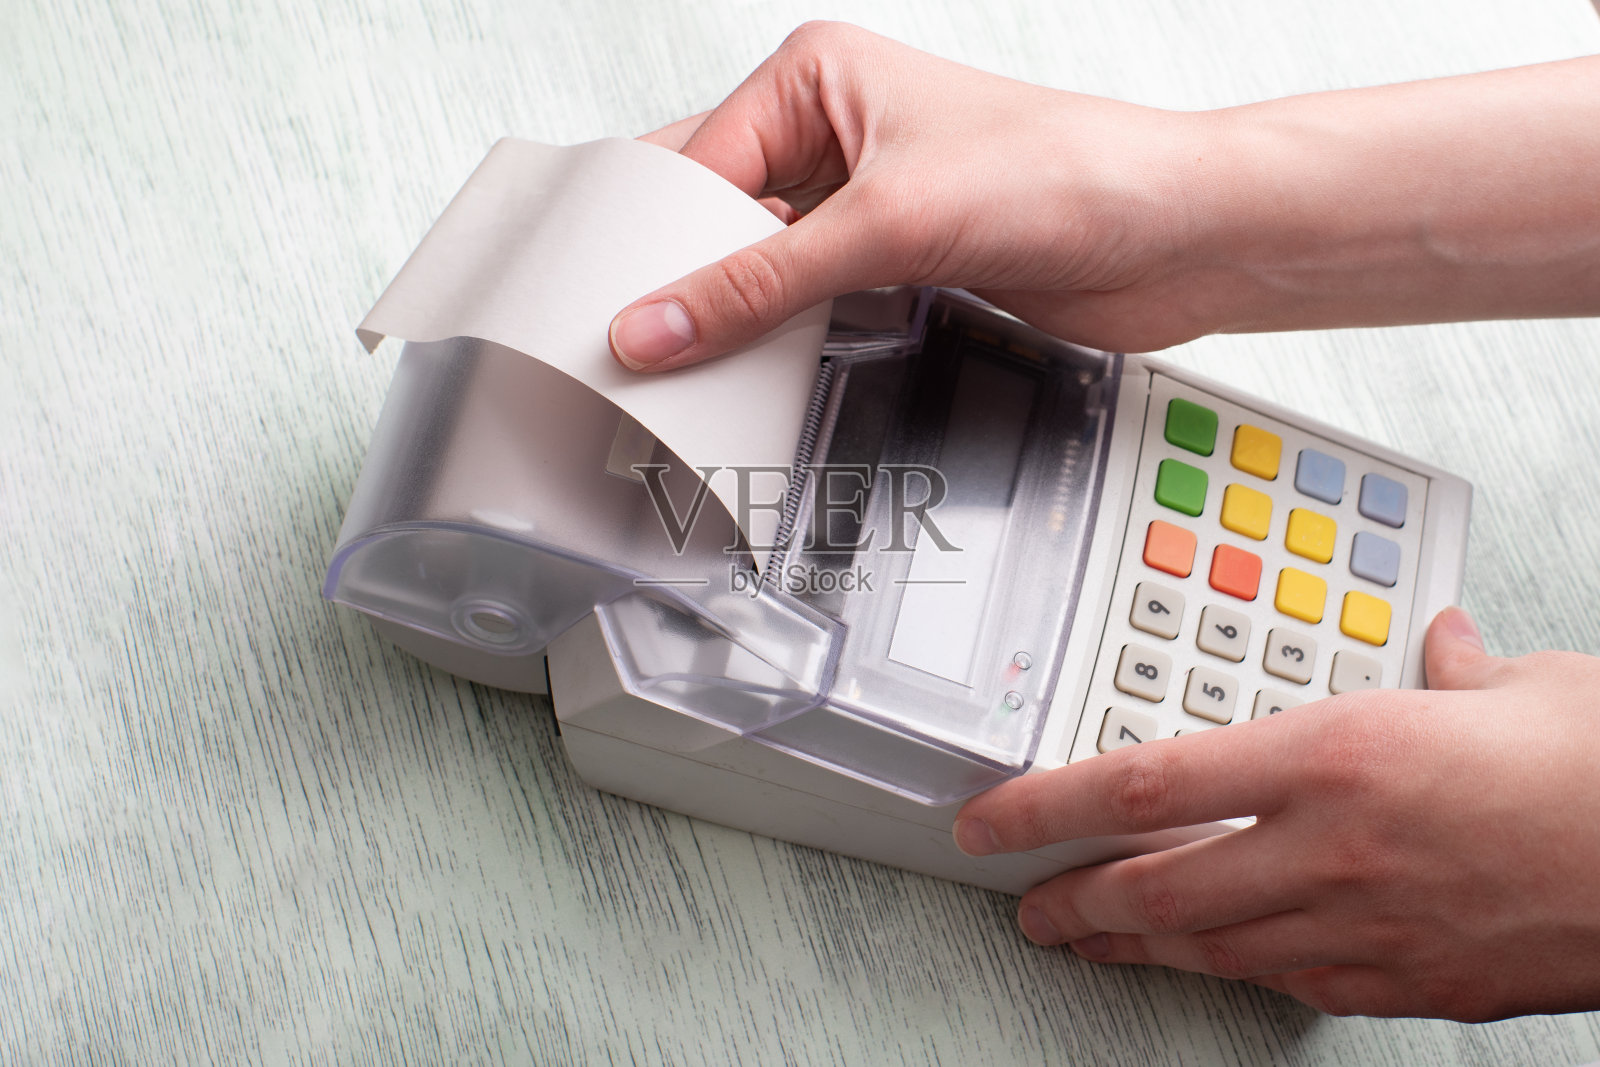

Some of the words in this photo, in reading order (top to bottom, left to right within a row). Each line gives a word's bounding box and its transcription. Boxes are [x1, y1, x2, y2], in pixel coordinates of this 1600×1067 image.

[1148, 600, 1170, 615] 9
[1215, 624, 1237, 639] 6
[1282, 645, 1304, 662] 3
[1135, 662, 1158, 680] 8
[1203, 683, 1225, 701] 5
[1120, 725, 1142, 744] 7
